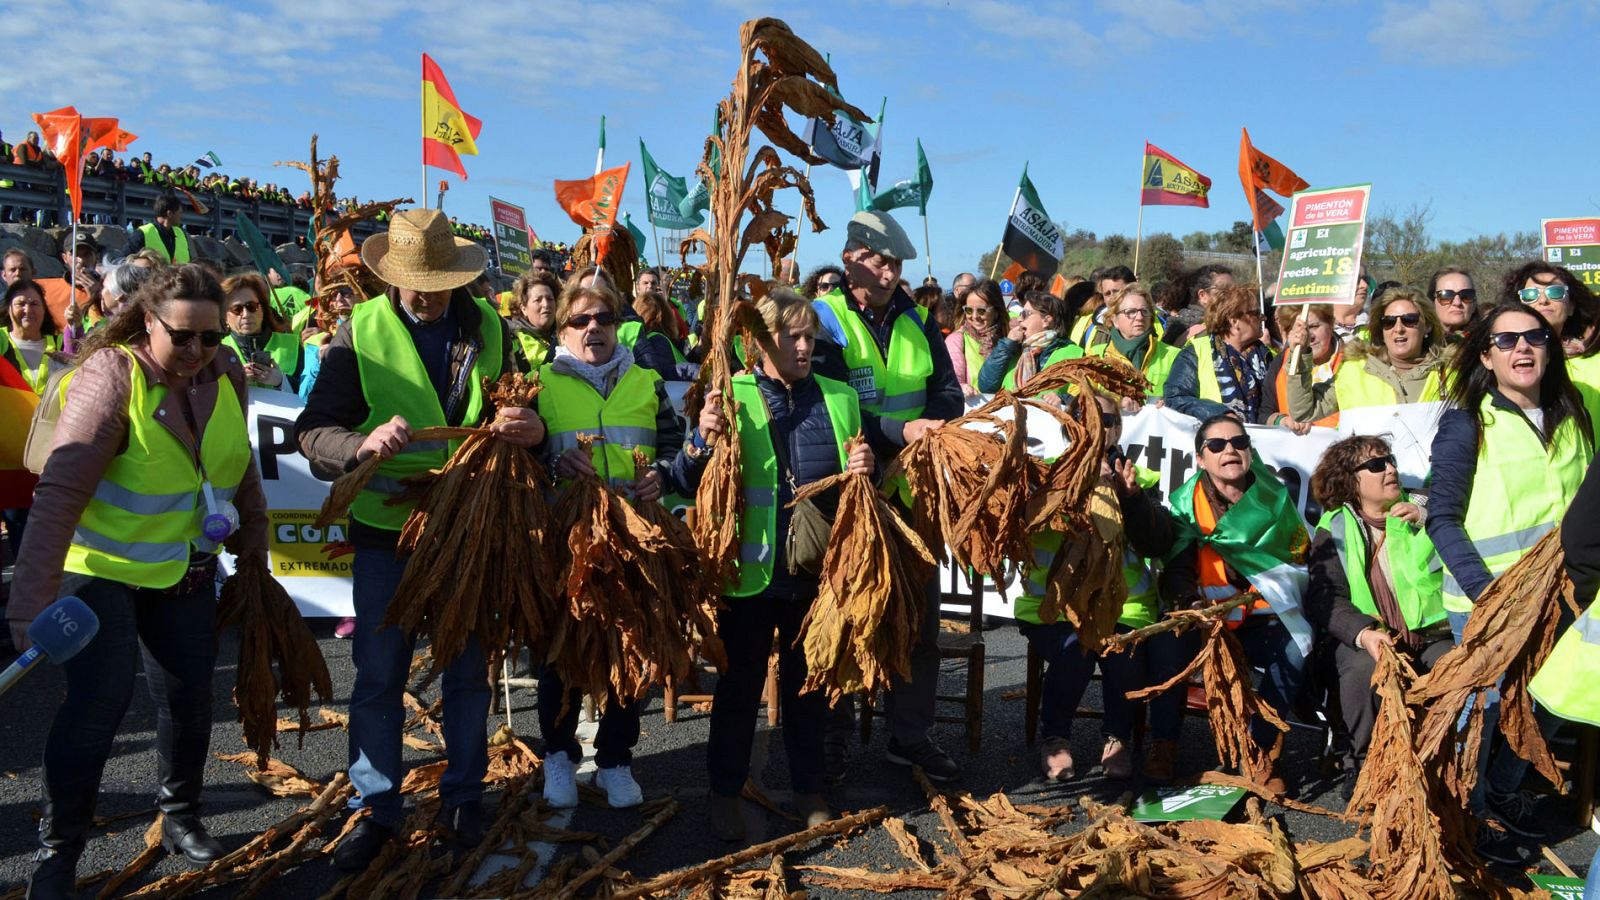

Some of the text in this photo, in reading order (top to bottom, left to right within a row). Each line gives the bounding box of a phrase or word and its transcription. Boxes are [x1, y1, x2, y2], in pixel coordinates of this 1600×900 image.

[1326, 208, 1349, 217] VERA
[1019, 207, 1060, 245] ASAJA
[518, 252, 530, 265] 18
[1290, 246, 1352, 261] agricultor
[1283, 256, 1353, 278] recibe 18
[272, 512, 322, 520] COORDINAD
[52, 607, 78, 636] tve
